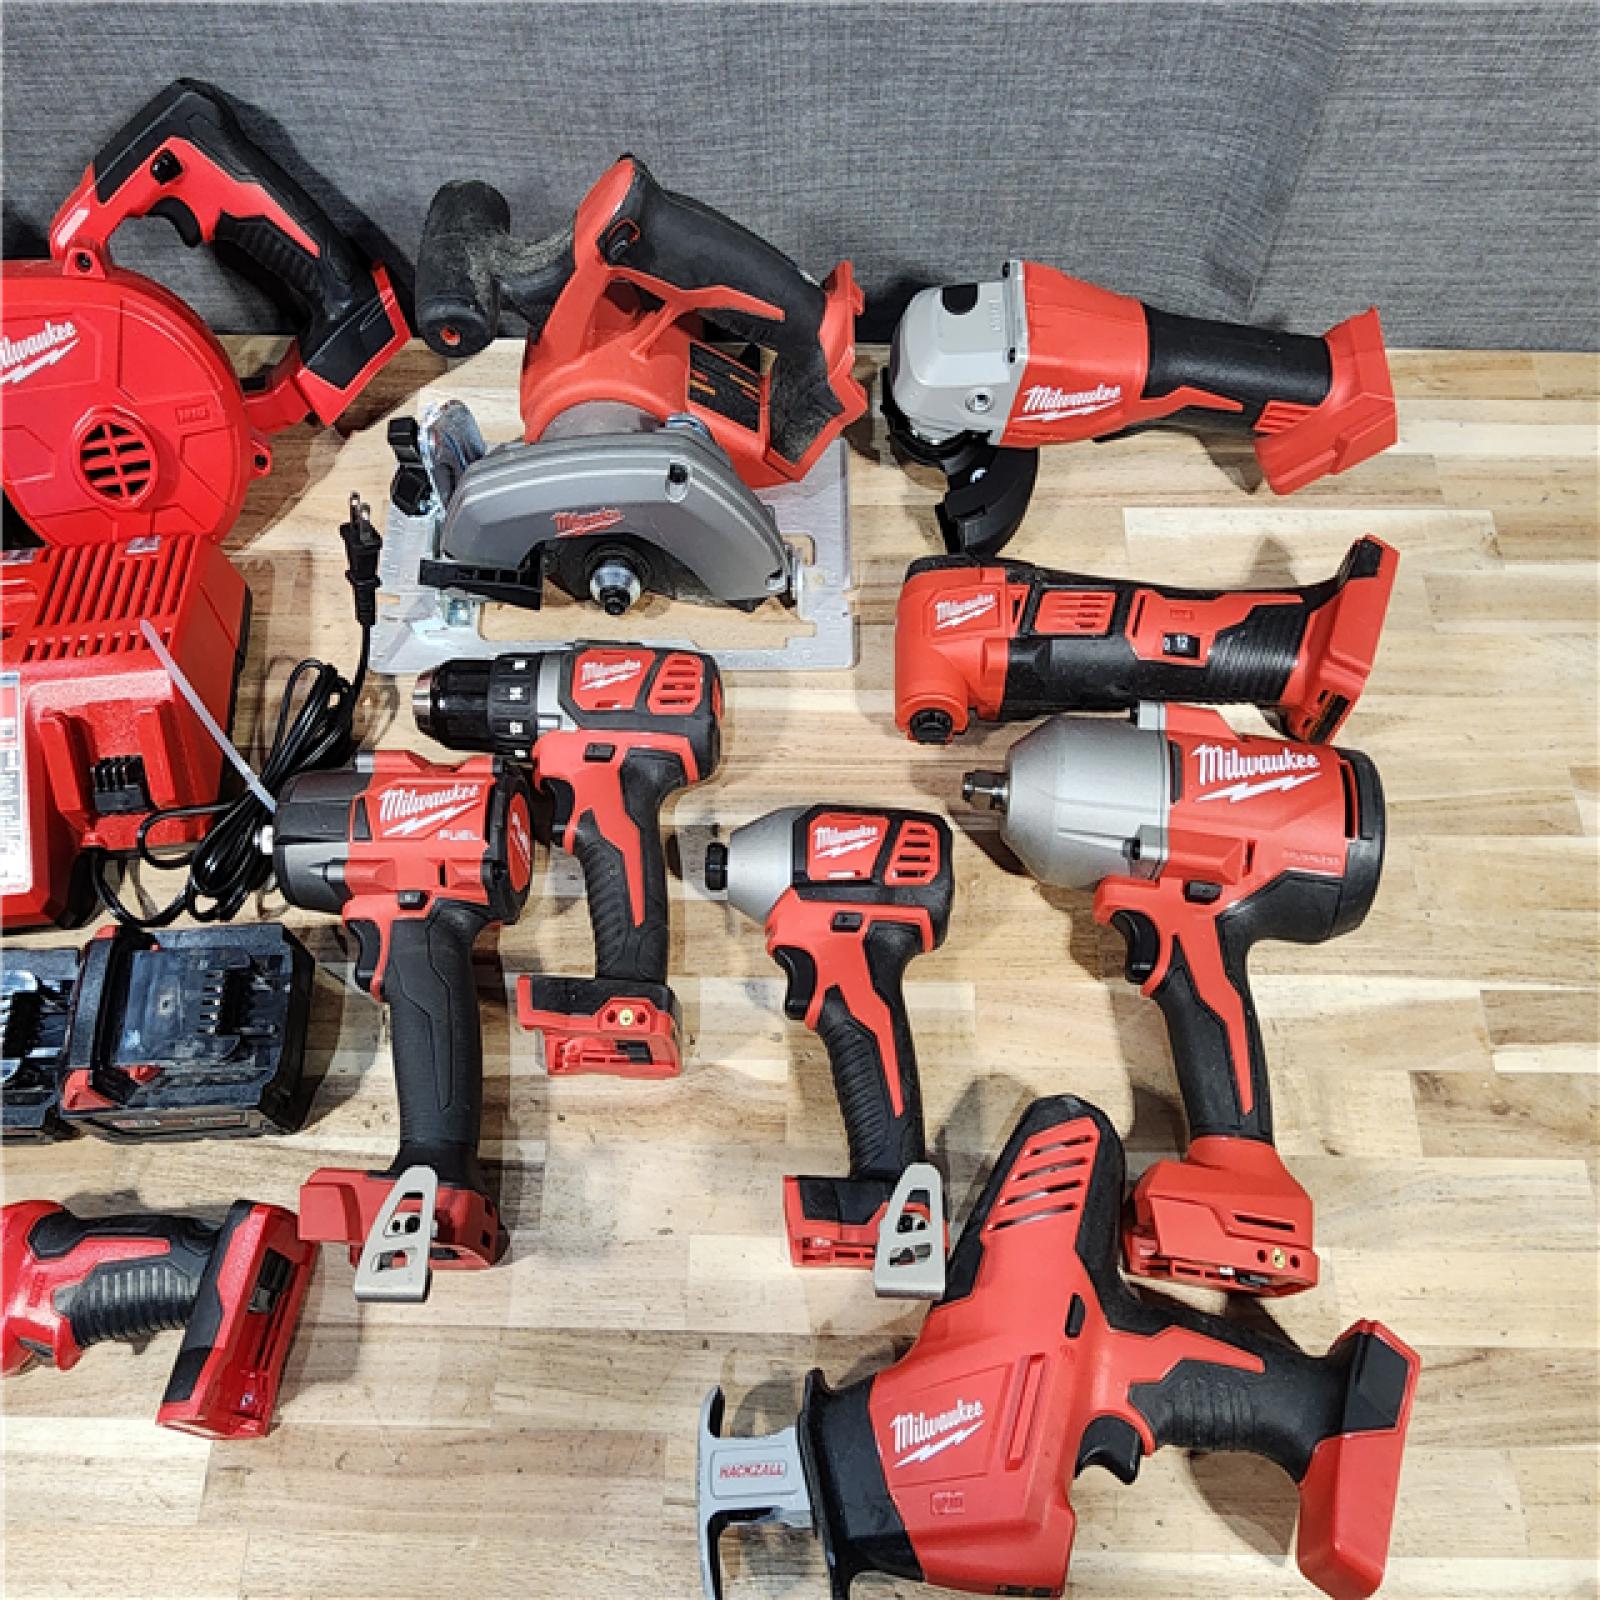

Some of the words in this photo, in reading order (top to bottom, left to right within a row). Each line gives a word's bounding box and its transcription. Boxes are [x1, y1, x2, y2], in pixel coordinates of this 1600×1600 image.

[0, 319, 78, 368] ilwaukee
[1022, 383, 1122, 413] Milwaukee
[935, 593, 996, 623] Milwaukee
[581, 659, 642, 685] Milwaukee
[1190, 743, 1321, 785] Milwaukee
[378, 784, 480, 824] Milwaukee
[438, 829, 480, 841] FUEL
[814, 825, 879, 851] Milwaukee
[889, 1398, 984, 1453] Milwaukee
[720, 1462, 784, 1479] HACKZALL
